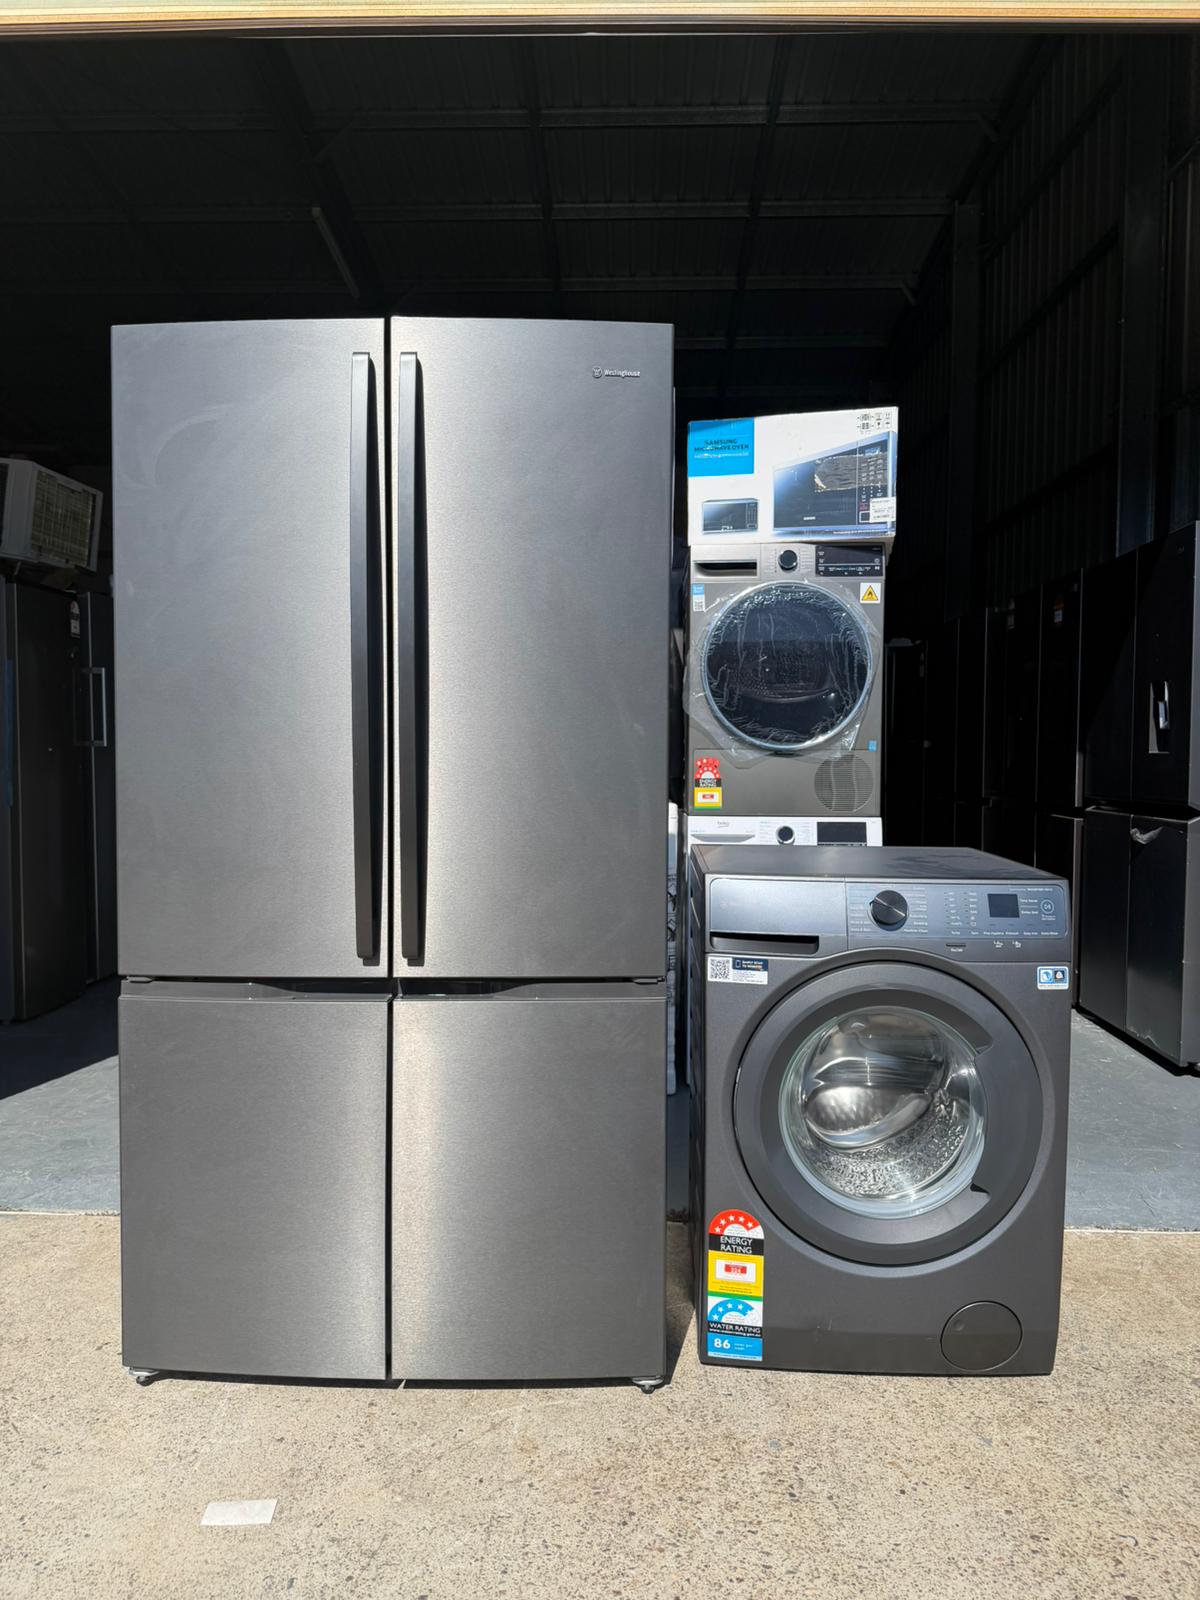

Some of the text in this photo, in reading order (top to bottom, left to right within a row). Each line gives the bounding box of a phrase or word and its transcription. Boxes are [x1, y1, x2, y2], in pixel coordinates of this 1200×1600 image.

[720, 1236, 753, 1246] ENERGY
[720, 1244, 752, 1254] RATING
[709, 1322, 761, 1334] WATER RATING
[713, 1338, 731, 1349] 86
